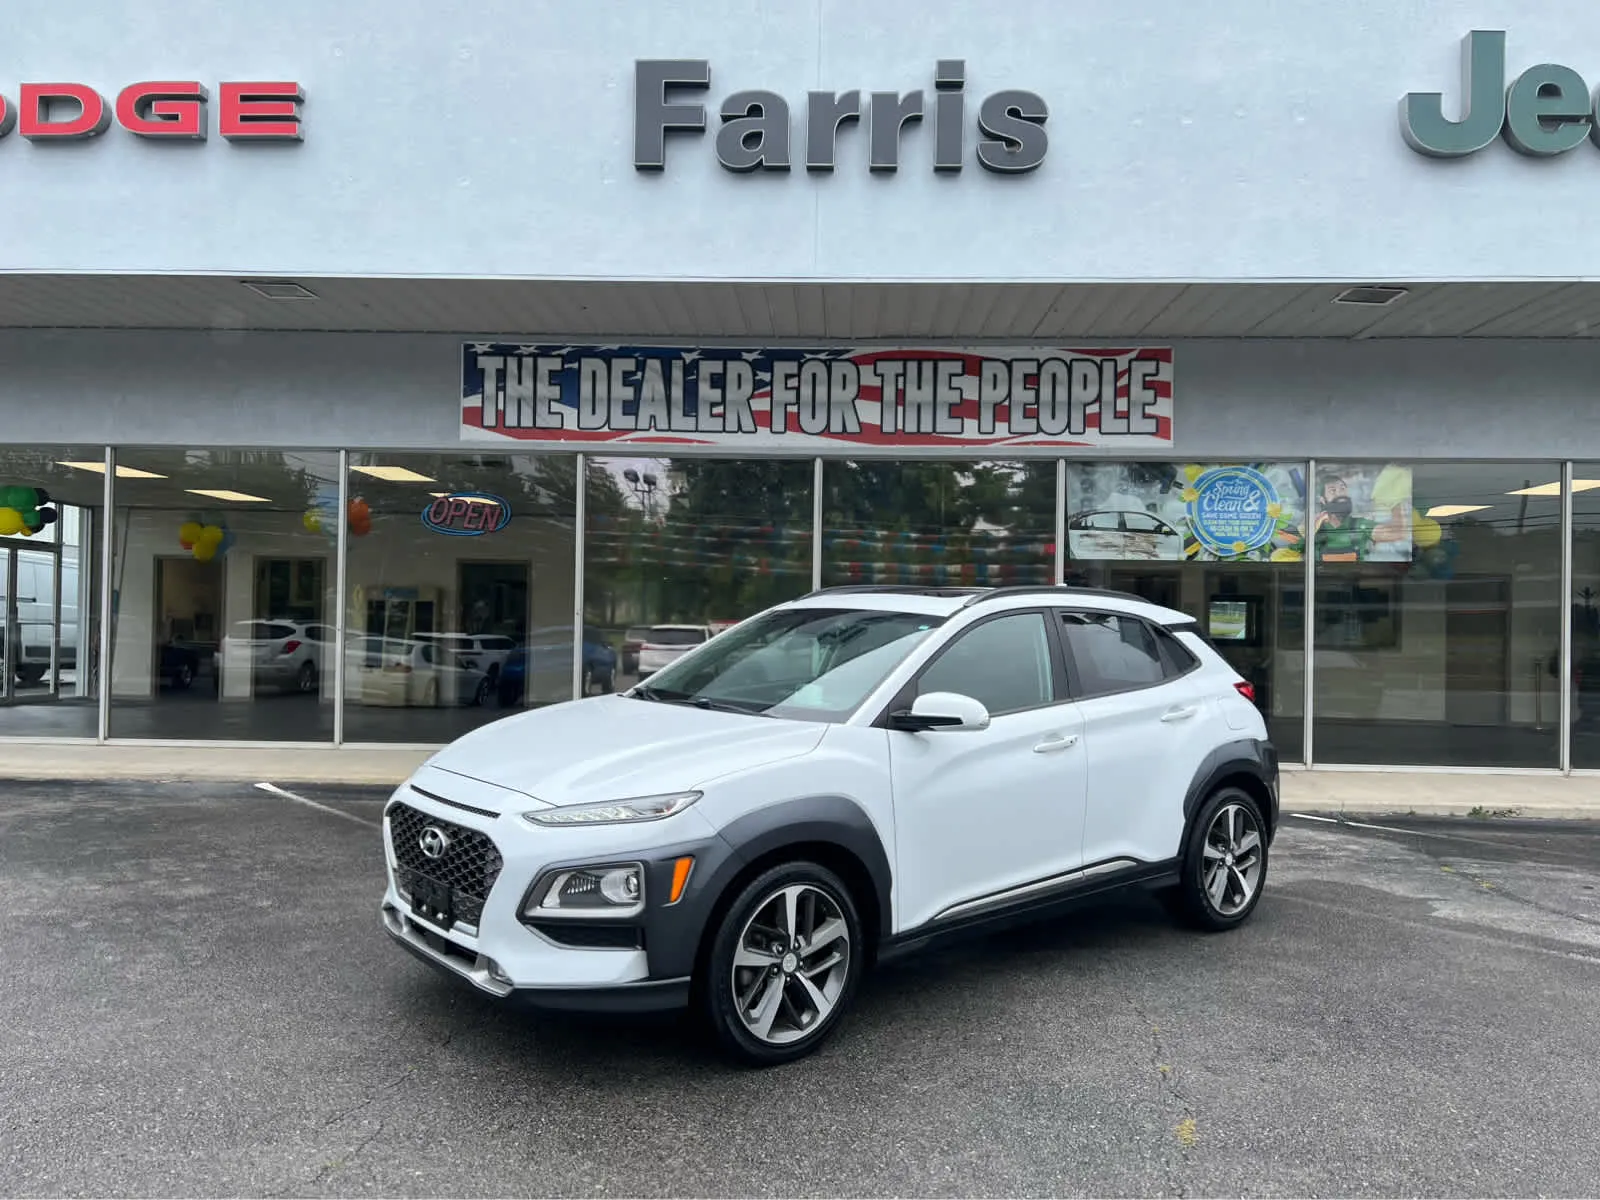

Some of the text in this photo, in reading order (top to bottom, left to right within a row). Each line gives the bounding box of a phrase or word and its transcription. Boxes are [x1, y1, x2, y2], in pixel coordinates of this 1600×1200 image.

[0, 81, 305, 143] DGE
[633, 59, 1049, 173] Farris
[1398, 30, 1600, 158] Je
[476, 355, 1160, 436] THE DEALER FOR THE PEOPLE
[430, 497, 500, 532] OPEN
[1202, 489, 1261, 513] Clean &
[1213, 480, 1250, 500] Spring
